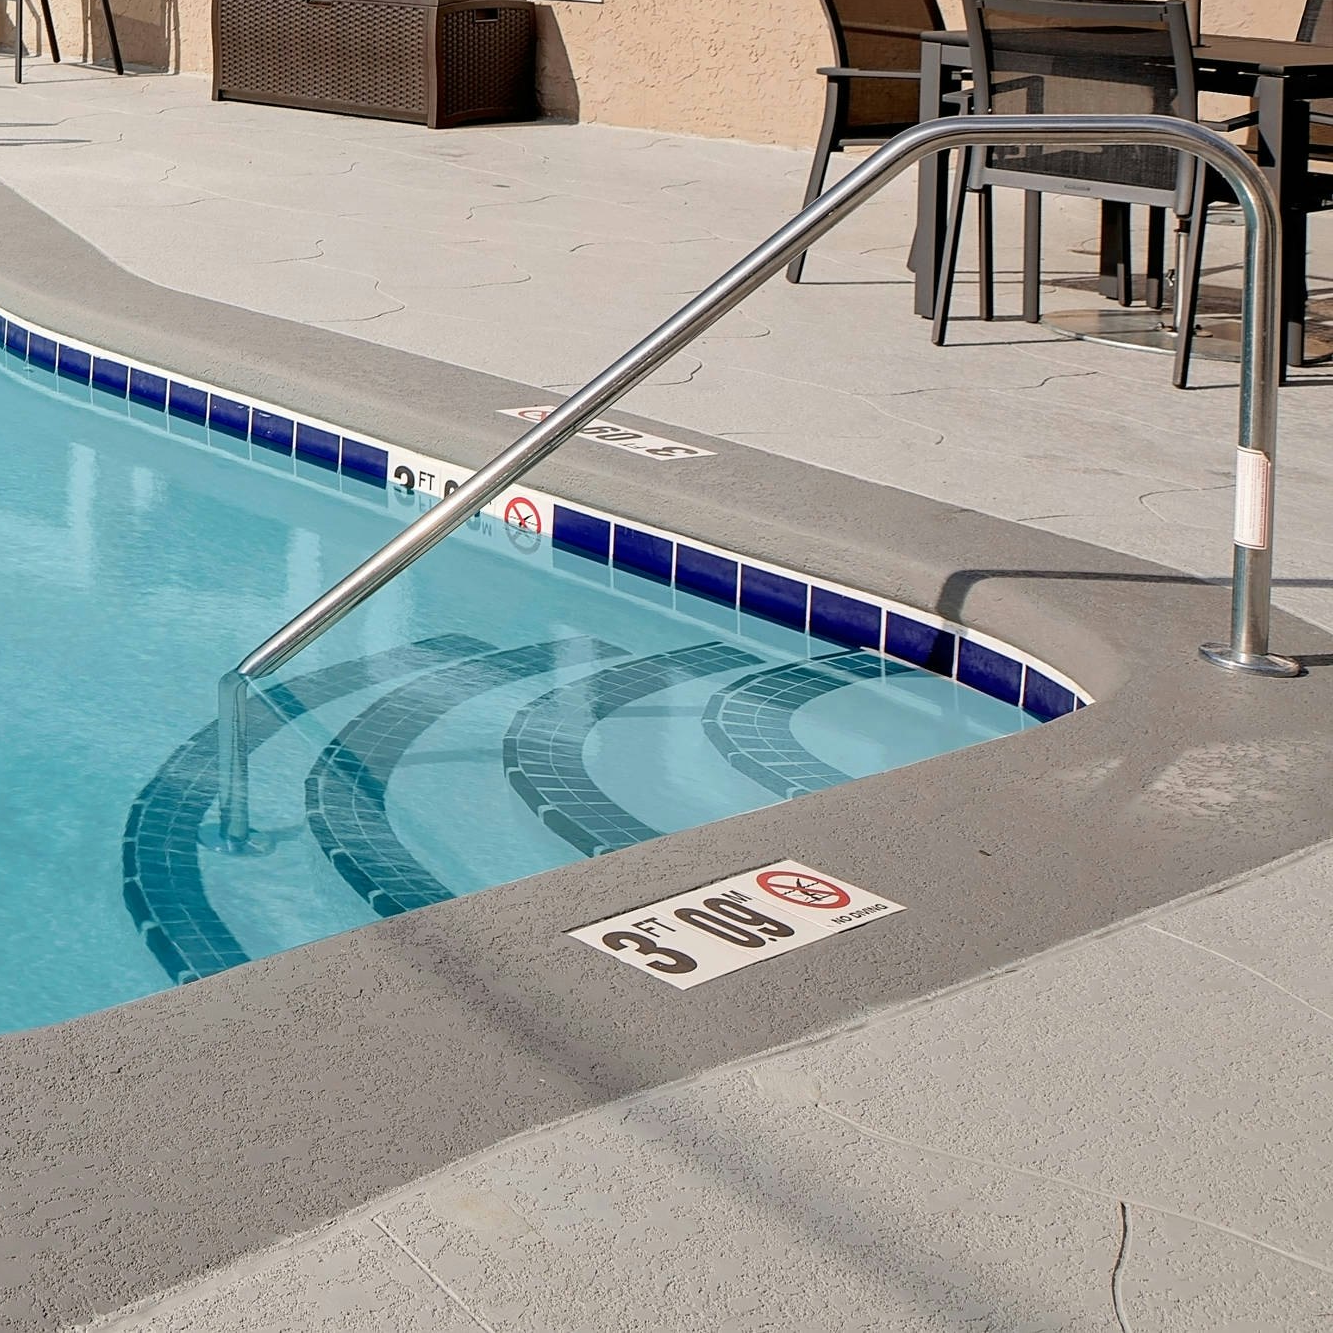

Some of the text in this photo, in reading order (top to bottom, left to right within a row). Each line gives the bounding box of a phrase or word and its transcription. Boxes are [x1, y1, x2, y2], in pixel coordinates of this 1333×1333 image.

[645, 446, 698, 457] 3
[419, 471, 435, 491] FT
[722, 890, 753, 905] M
[631, 916, 677, 938] FT
[602, 930, 697, 974] 3
